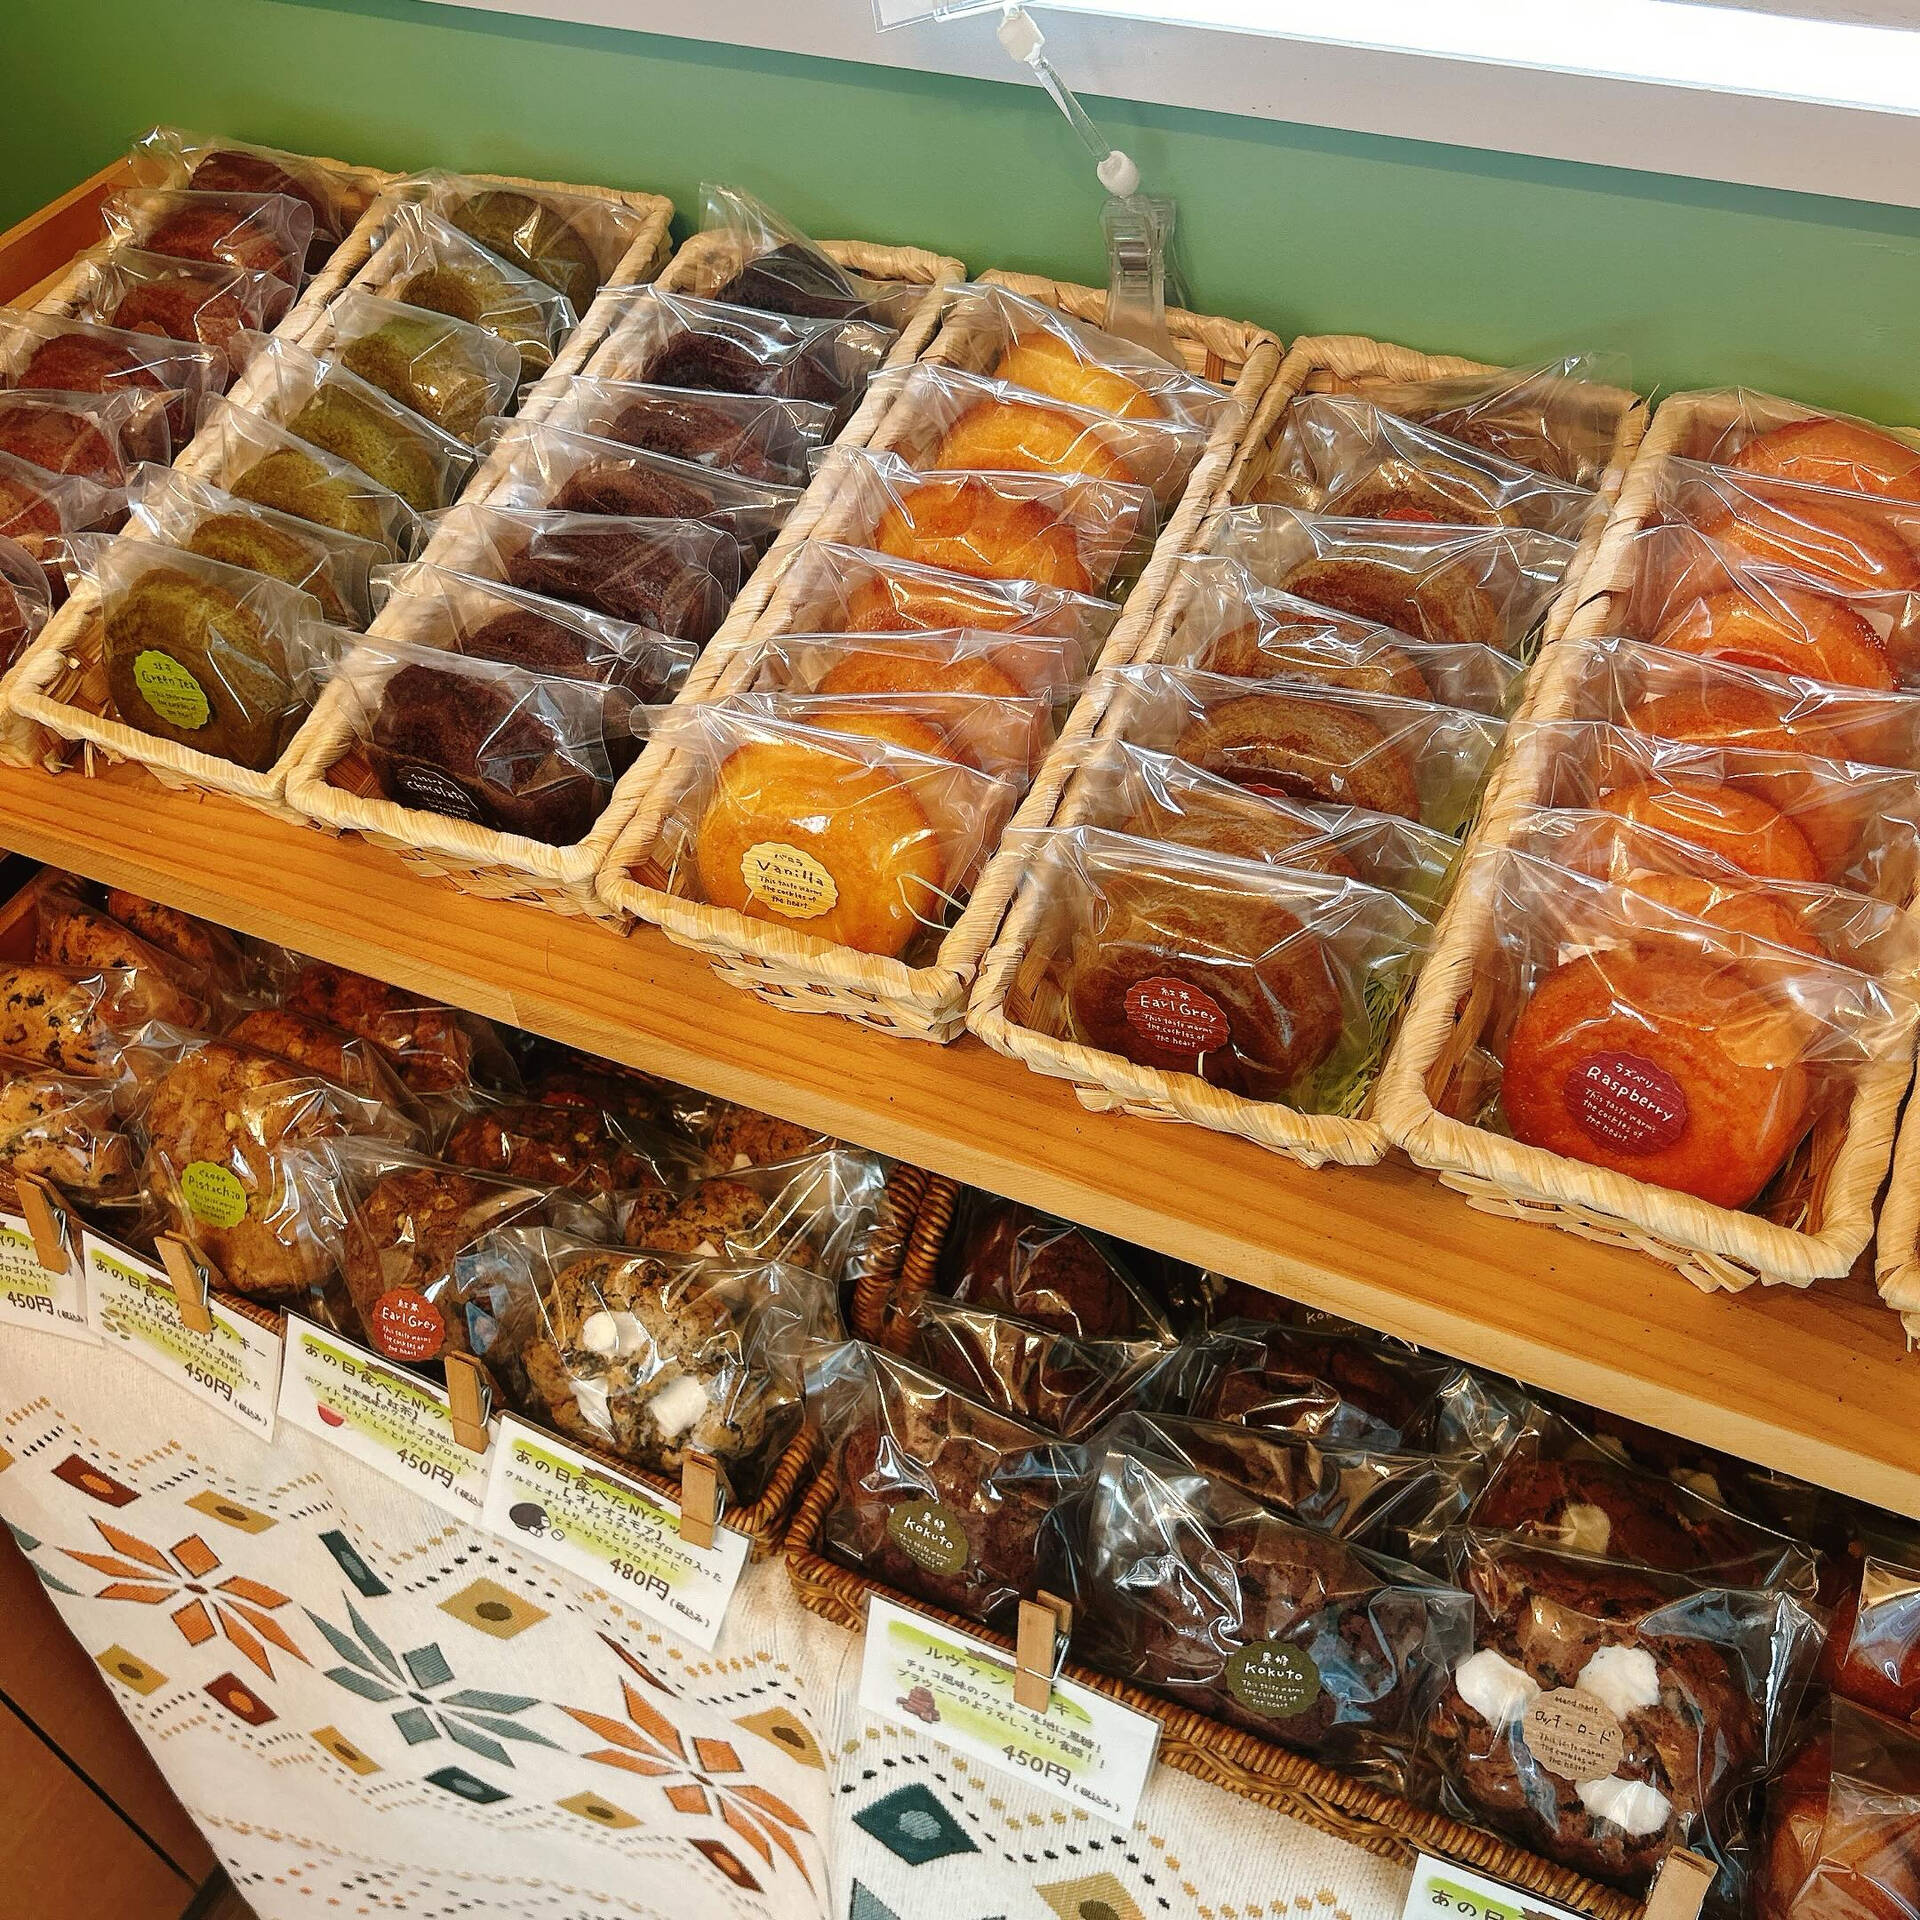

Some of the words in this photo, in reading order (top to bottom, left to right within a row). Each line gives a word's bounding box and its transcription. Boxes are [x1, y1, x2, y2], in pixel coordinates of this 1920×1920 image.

[142, 670, 175, 684] Green
[177, 678, 197, 690] Tea
[757, 859, 824, 886] Vanilla
[760, 876, 776, 885] This
[1140, 995, 1175, 1011] Earl
[1180, 1003, 1217, 1023] Grey
[1143, 1013, 1161, 1022] This
[1615, 1062, 1662, 1092] ラズベリー
[1585, 1088, 1603, 1103] This
[1586, 1066, 1674, 1122] Raspberry
[1633, 1130, 1644, 1139] of
[7, 1291, 54, 1315] 450円
[382, 1306, 406, 1323] Earl
[408, 1315, 437, 1332] Grey
[184, 1362, 233, 1402] 450円
[397, 1448, 454, 1489] 450円
[903, 1516, 954, 1549] Kokuto
[609, 1558, 670, 1601] 480円
[1244, 1661, 1303, 1681] Kokuto
[1535, 1710, 1616, 1745] ロッキーロード
[1001, 1744, 1072, 1787] 450円
